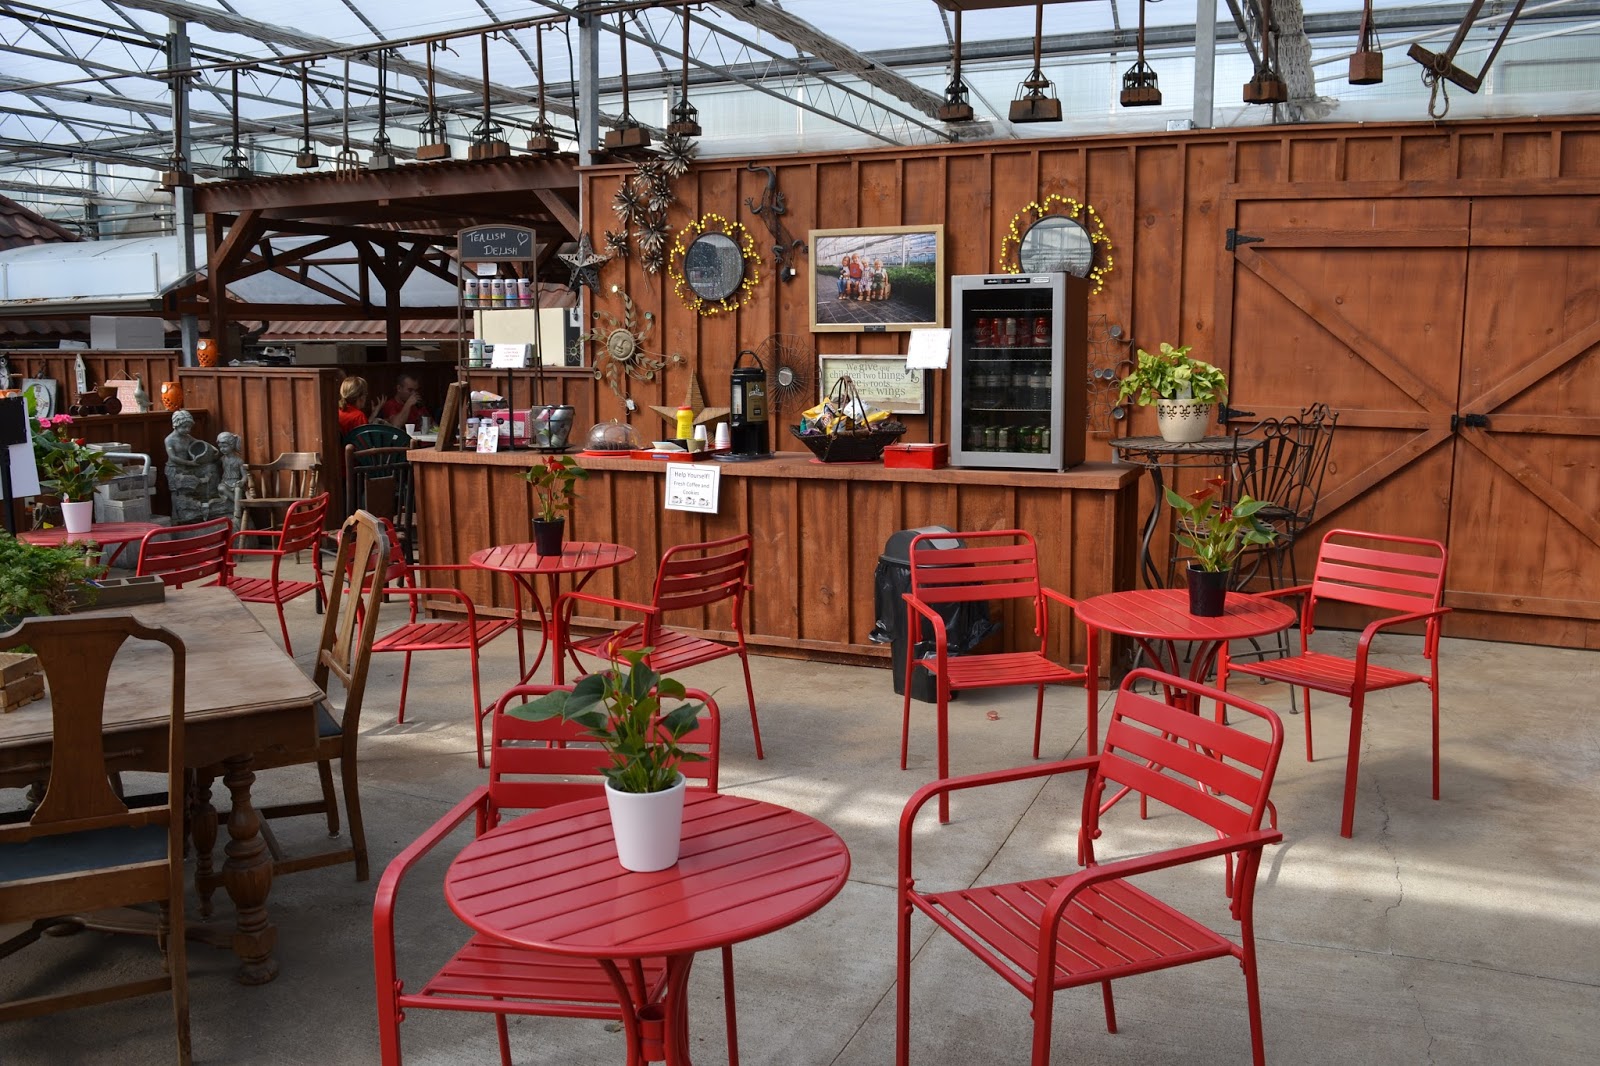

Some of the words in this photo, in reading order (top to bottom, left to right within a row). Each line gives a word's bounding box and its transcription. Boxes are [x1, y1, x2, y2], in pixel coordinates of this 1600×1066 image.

[466, 231, 506, 242] TEALISH
[484, 245, 518, 256] DELISH
[859, 362, 878, 372] give
[830, 370, 861, 379] children
[878, 371, 905, 381] things
[876, 388, 906, 398] wings
